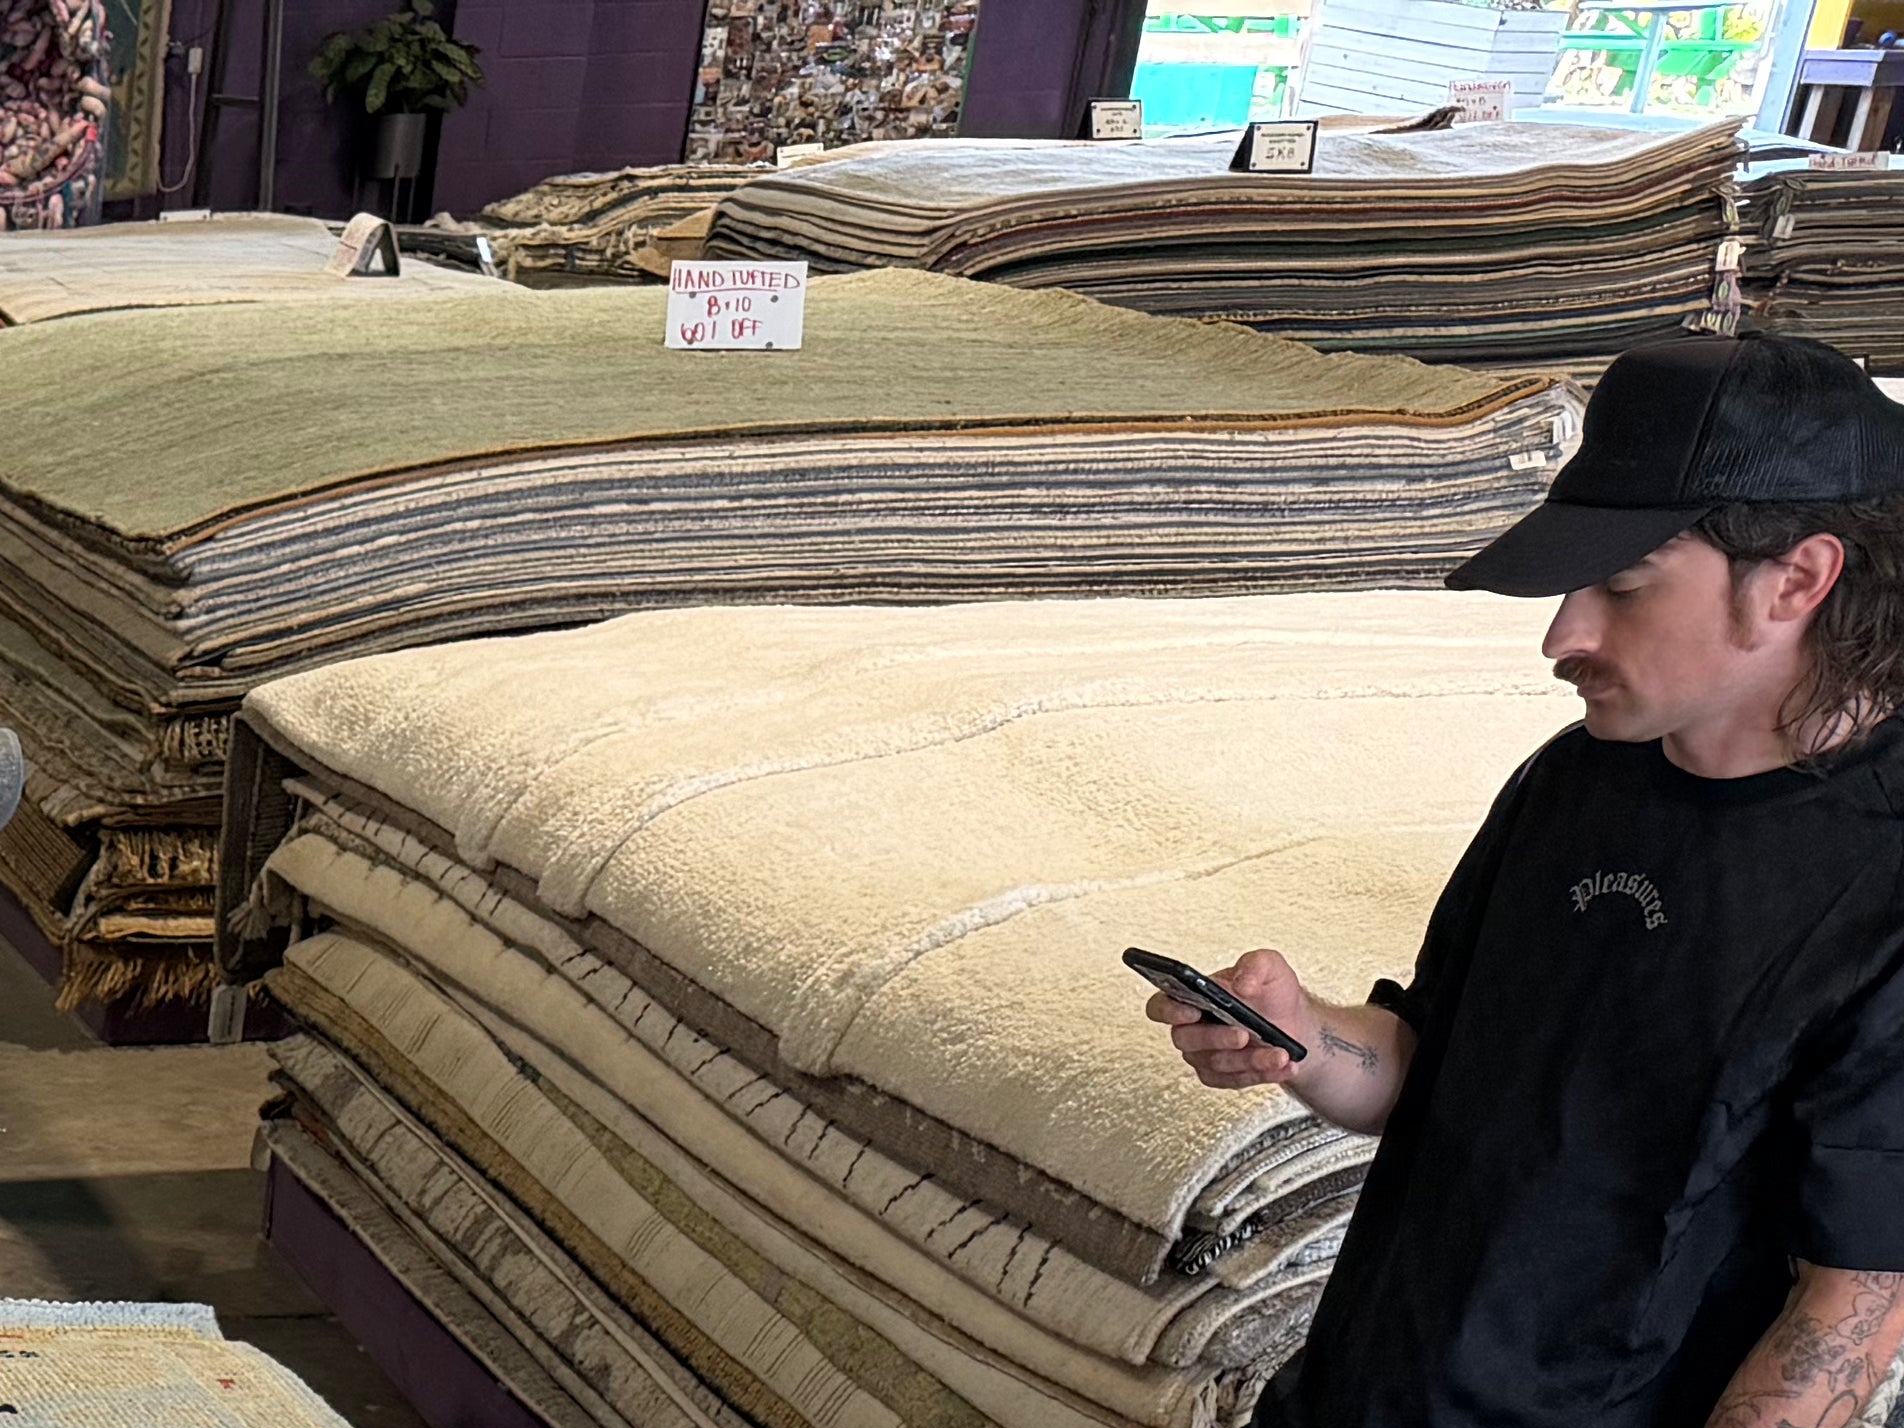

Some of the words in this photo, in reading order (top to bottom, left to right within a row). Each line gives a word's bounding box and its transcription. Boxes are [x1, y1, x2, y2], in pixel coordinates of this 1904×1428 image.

[672, 268, 725, 291] HAND
[728, 269, 801, 289] TUFTED
[731, 317, 763, 339] OFF
[1569, 869, 1669, 930] Pleasures
